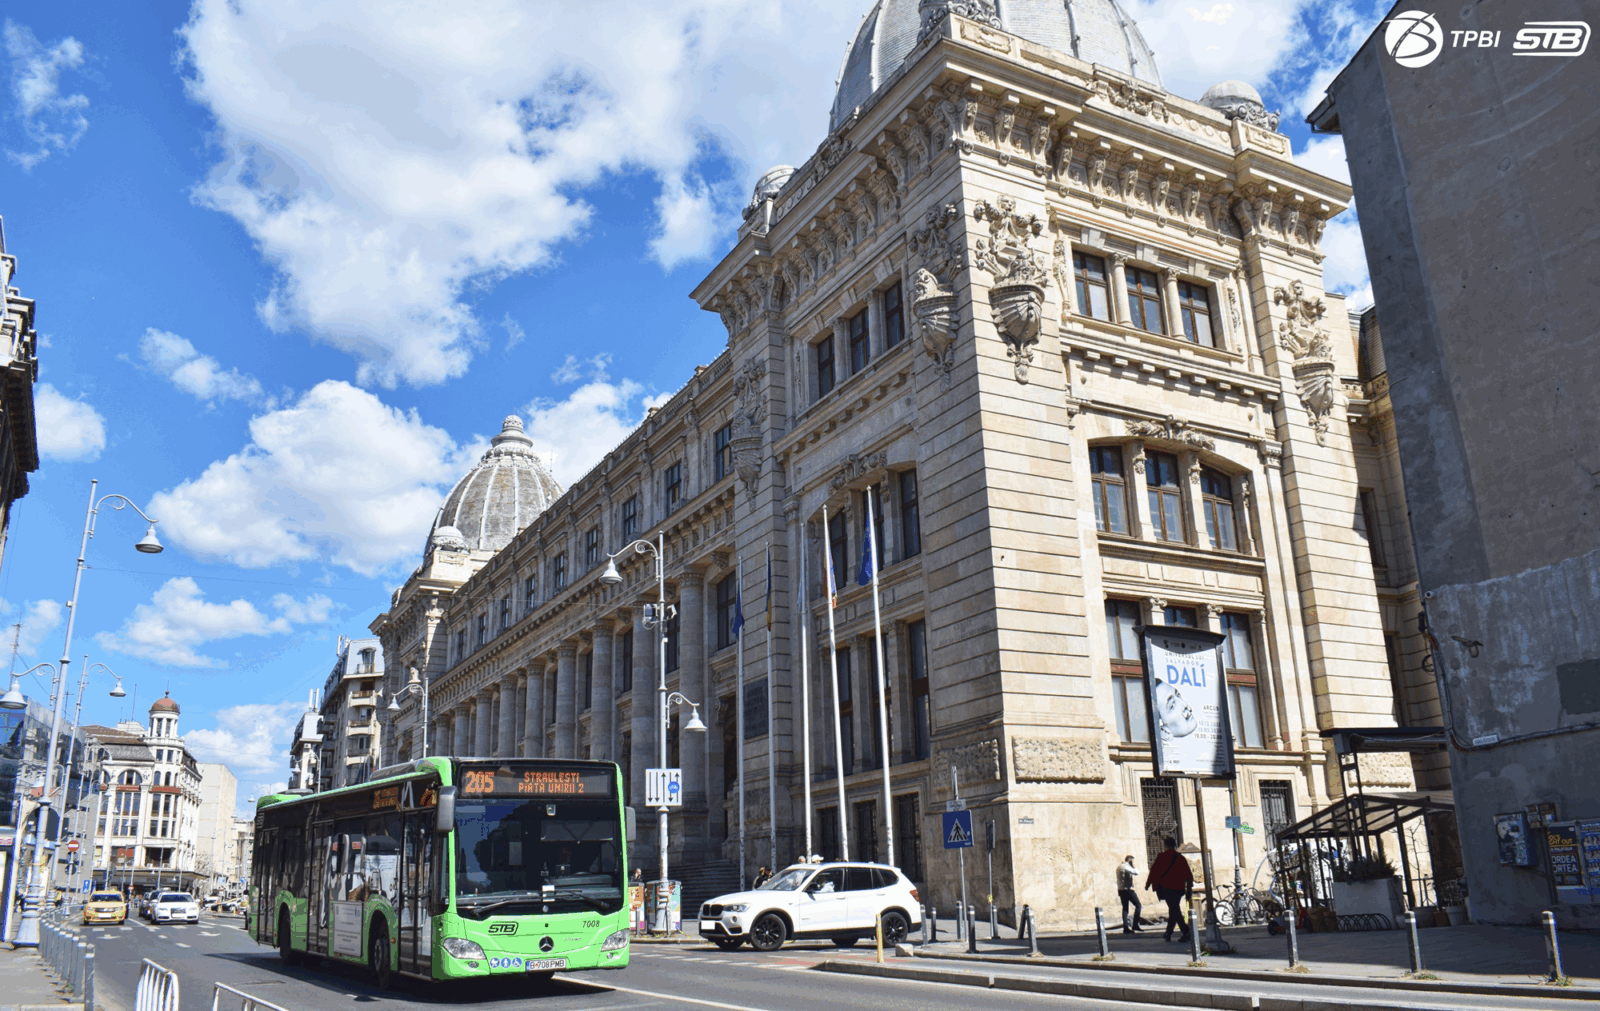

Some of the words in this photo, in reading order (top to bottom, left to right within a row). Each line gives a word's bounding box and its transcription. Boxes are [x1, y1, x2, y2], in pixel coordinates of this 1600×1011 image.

[1165, 651, 1194, 660] UNIVERSUL
[1165, 657, 1199, 666] SALVADOR
[1166, 663, 1206, 687] DALÍ
[465, 771, 494, 793] 205
[578, 783, 584, 793] 2
[1552, 854, 1577, 864] ORDEA
[1552, 863, 1579, 873] ORTEA
[488, 923, 517, 934] STB
[582, 920, 600, 928] 7008
